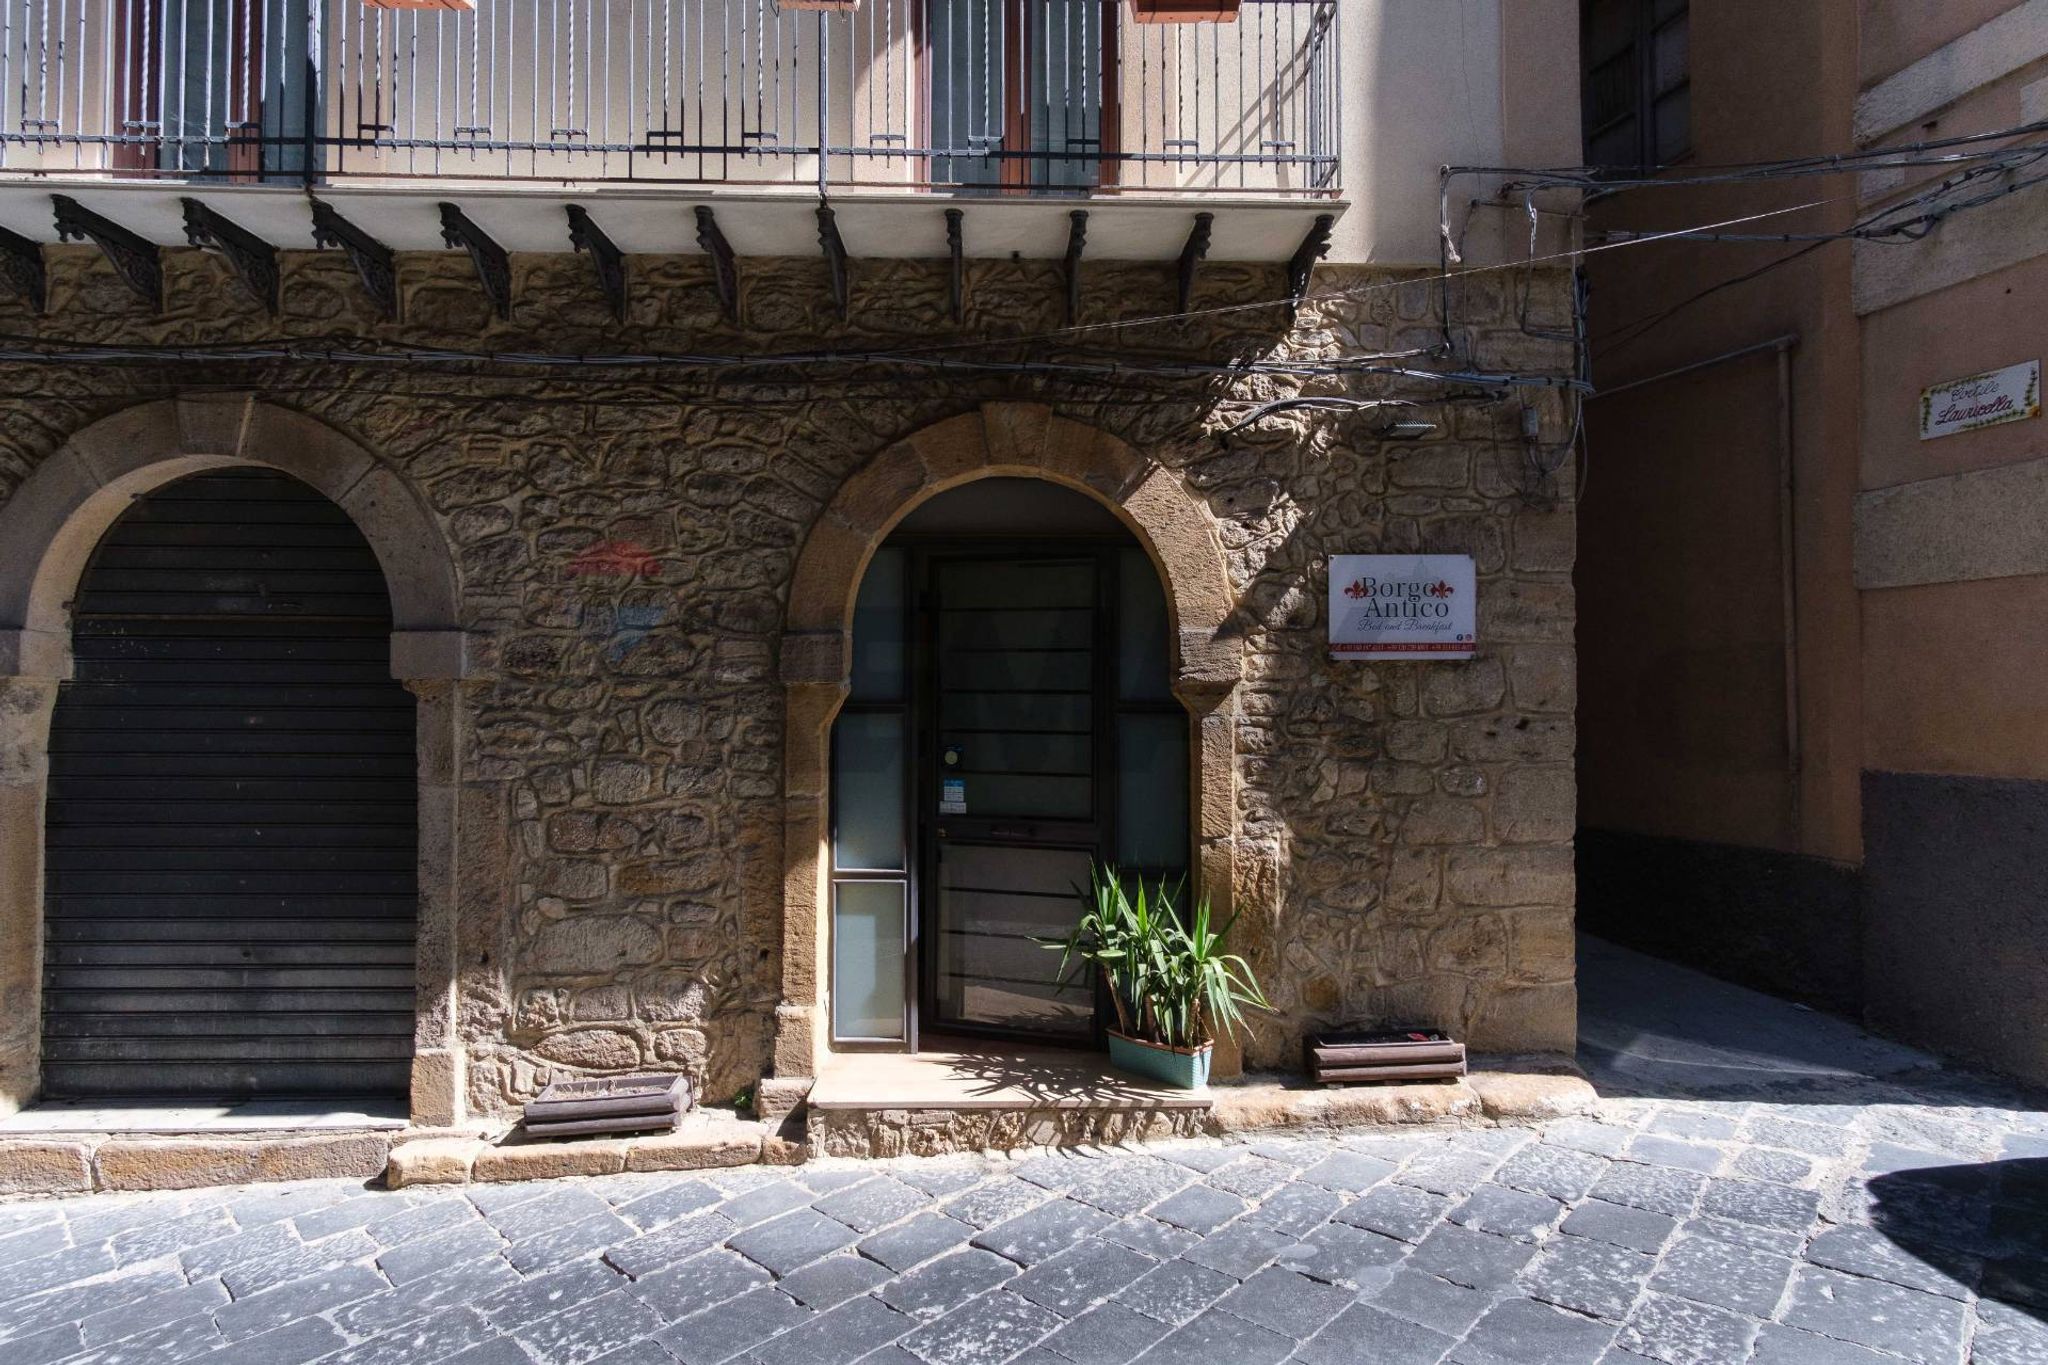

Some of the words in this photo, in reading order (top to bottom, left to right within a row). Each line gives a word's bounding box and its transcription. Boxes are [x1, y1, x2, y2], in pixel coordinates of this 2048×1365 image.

[1951, 380, 2001, 402] Cortile
[1934, 395, 2014, 426] Lauricella
[1362, 577, 1437, 602] Borgo
[1363, 597, 1449, 618] Antico
[1357, 618, 1382, 632] Bed
[1384, 621, 1401, 631] and
[1403, 618, 1453, 634] Breakfast
